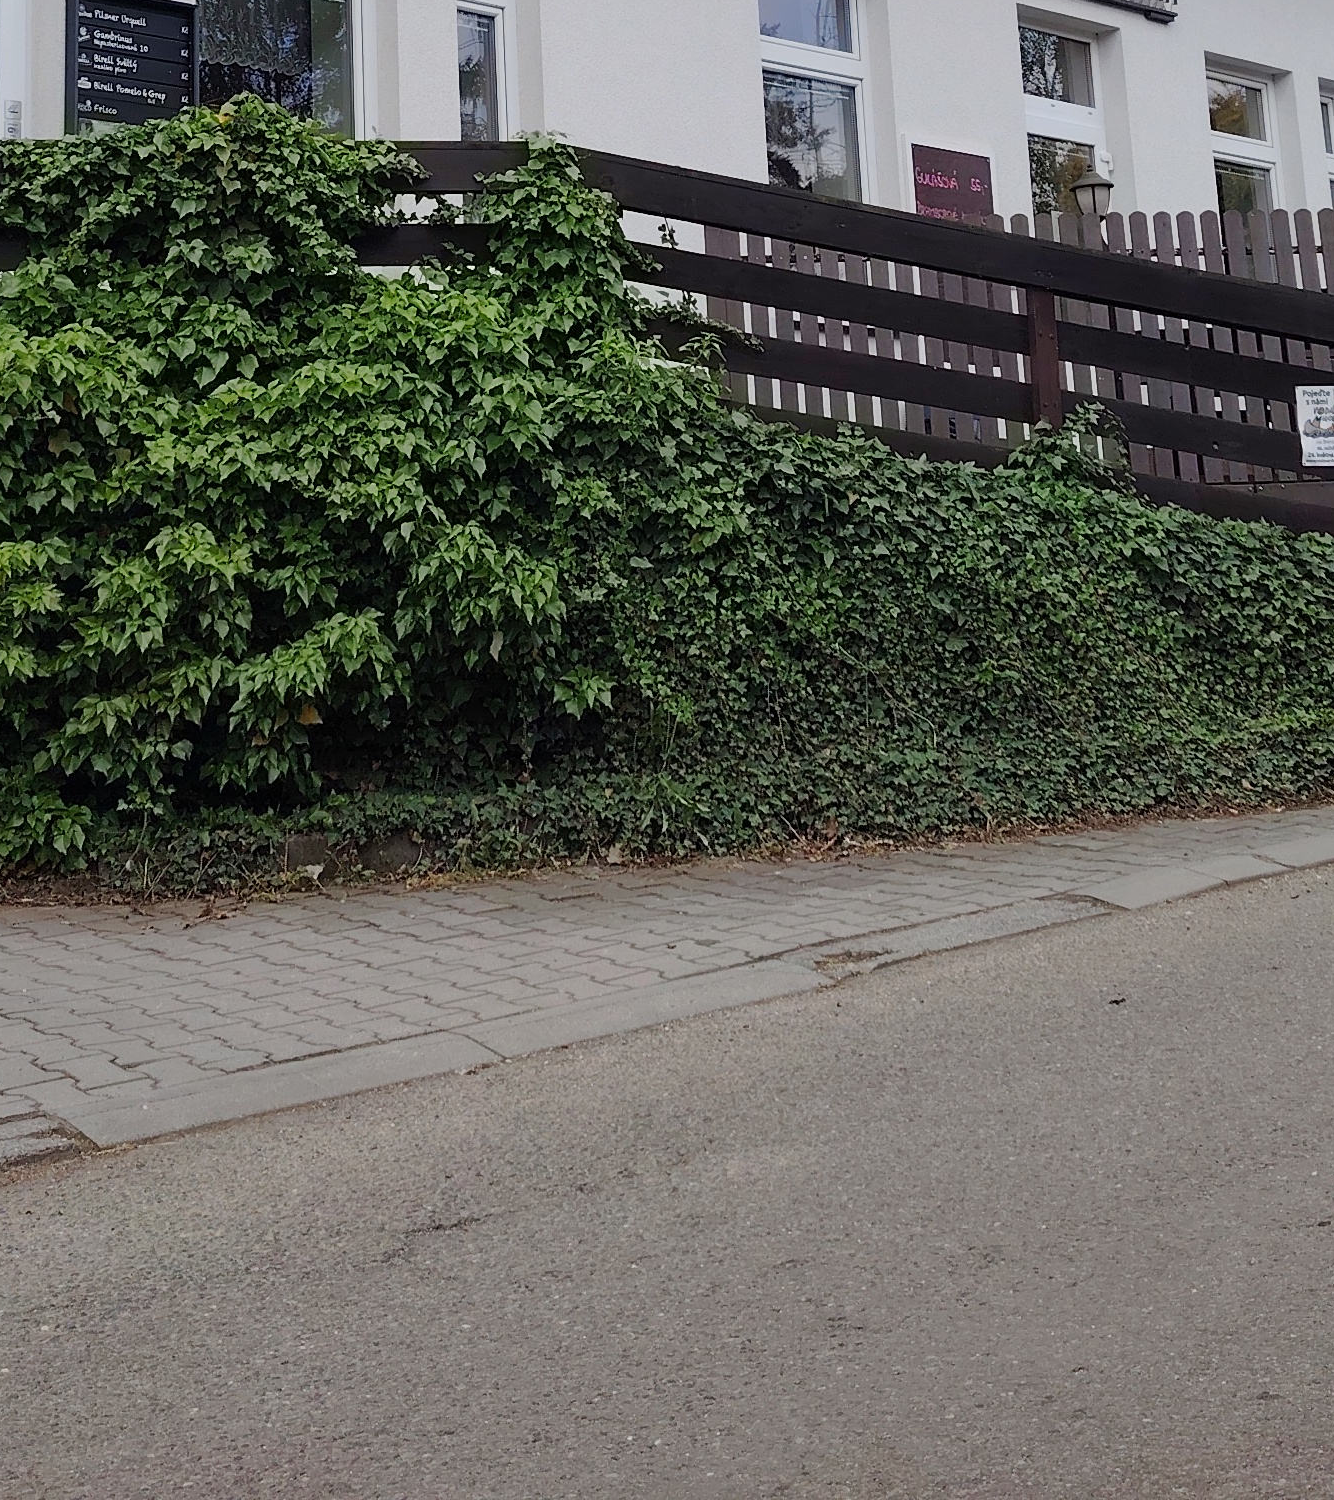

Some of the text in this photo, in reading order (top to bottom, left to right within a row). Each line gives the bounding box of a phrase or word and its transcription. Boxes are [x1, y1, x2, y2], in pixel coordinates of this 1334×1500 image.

[94, 9, 119, 22] Pilsner
[93, 29, 133, 44] Gambrinus
[93, 53, 114, 65] Birell
[93, 81, 114, 92] Birell
[93, 104, 118, 115] Frisco
